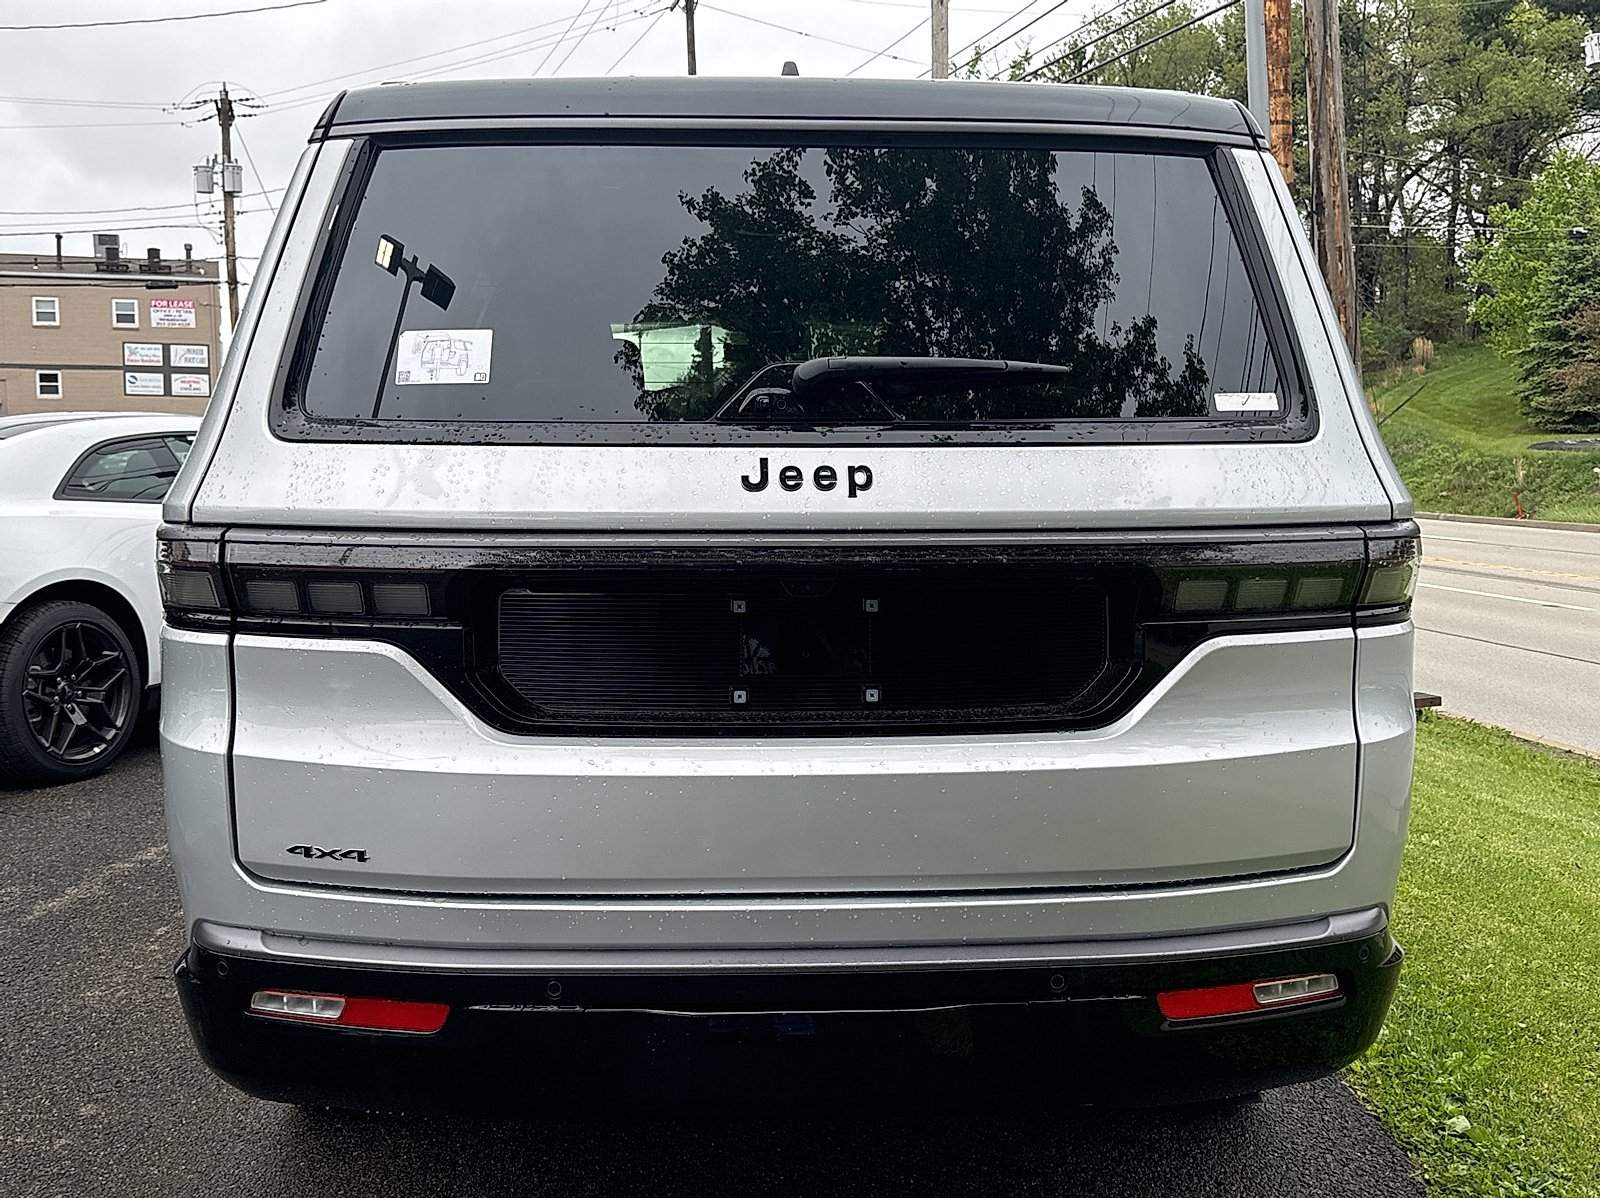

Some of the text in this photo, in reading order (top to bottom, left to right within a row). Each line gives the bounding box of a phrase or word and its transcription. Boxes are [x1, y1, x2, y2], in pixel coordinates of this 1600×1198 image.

[151, 300, 193, 308] FOR LEASE
[741, 457, 873, 498] Jeep
